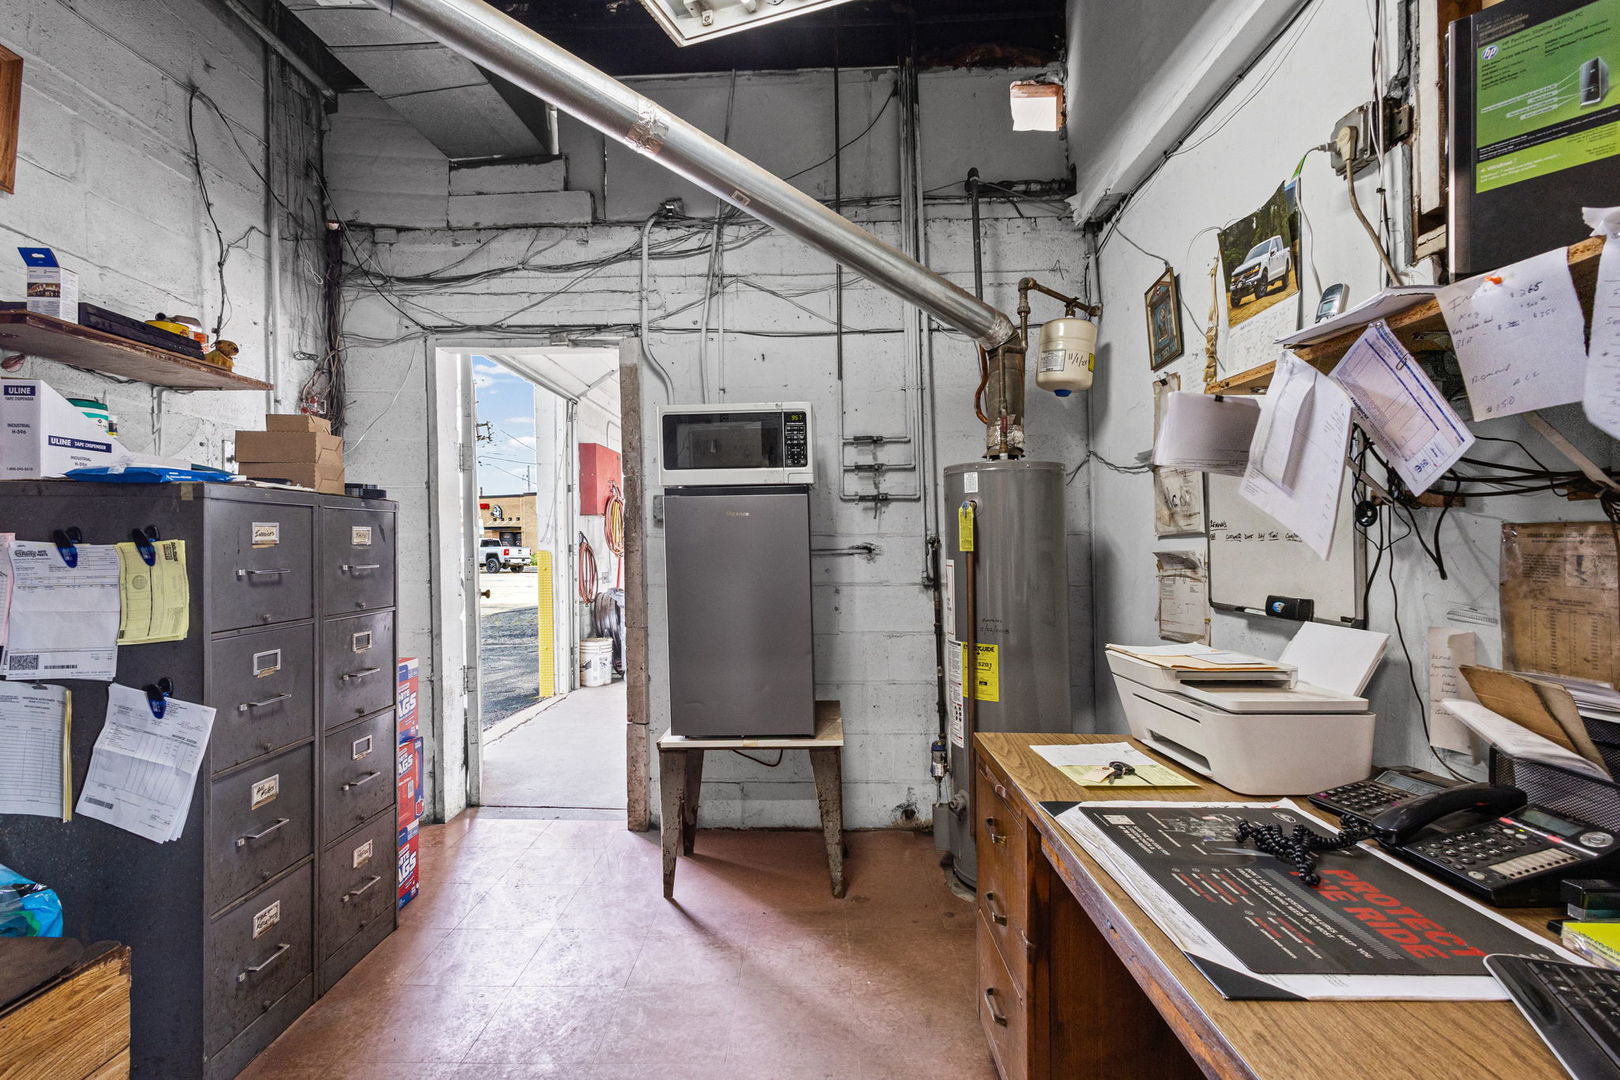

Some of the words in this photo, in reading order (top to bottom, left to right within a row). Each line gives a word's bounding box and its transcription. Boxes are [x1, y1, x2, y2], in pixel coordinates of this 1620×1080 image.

[8, 387, 31, 395] ULINE
[50, 437, 72, 447] ULINE
[1320, 869, 1487, 957] PROTECT
[1343, 907, 1451, 959] RIDE
